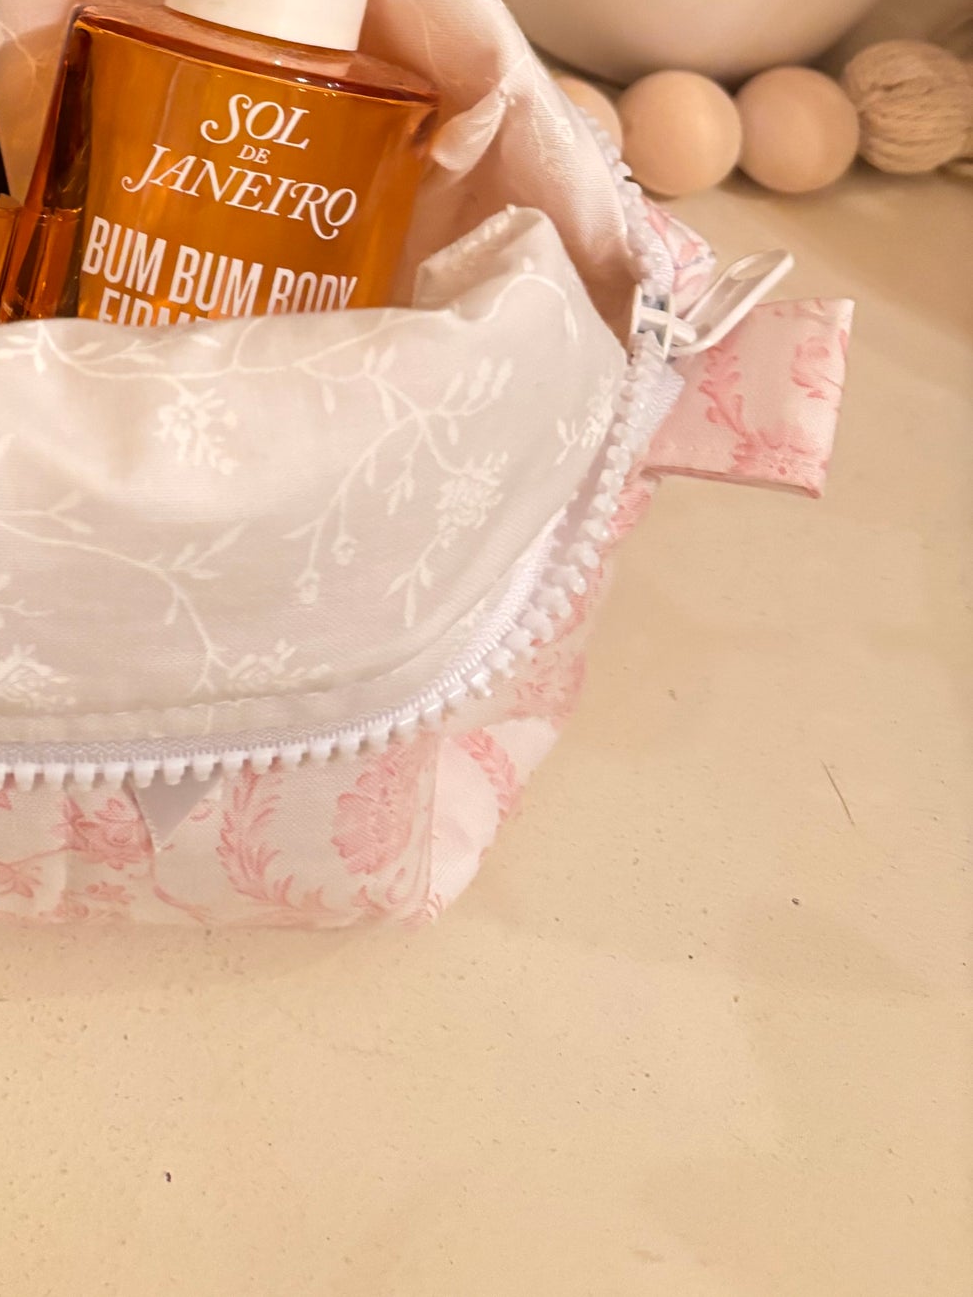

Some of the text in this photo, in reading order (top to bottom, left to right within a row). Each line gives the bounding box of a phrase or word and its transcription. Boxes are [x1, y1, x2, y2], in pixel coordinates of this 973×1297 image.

[200, 93, 311, 150] SOL
[237, 144, 271, 165] DE
[121, 143, 357, 240] JANEIRO
[82, 216, 167, 296] BUM
[169, 245, 264, 319] BUM
